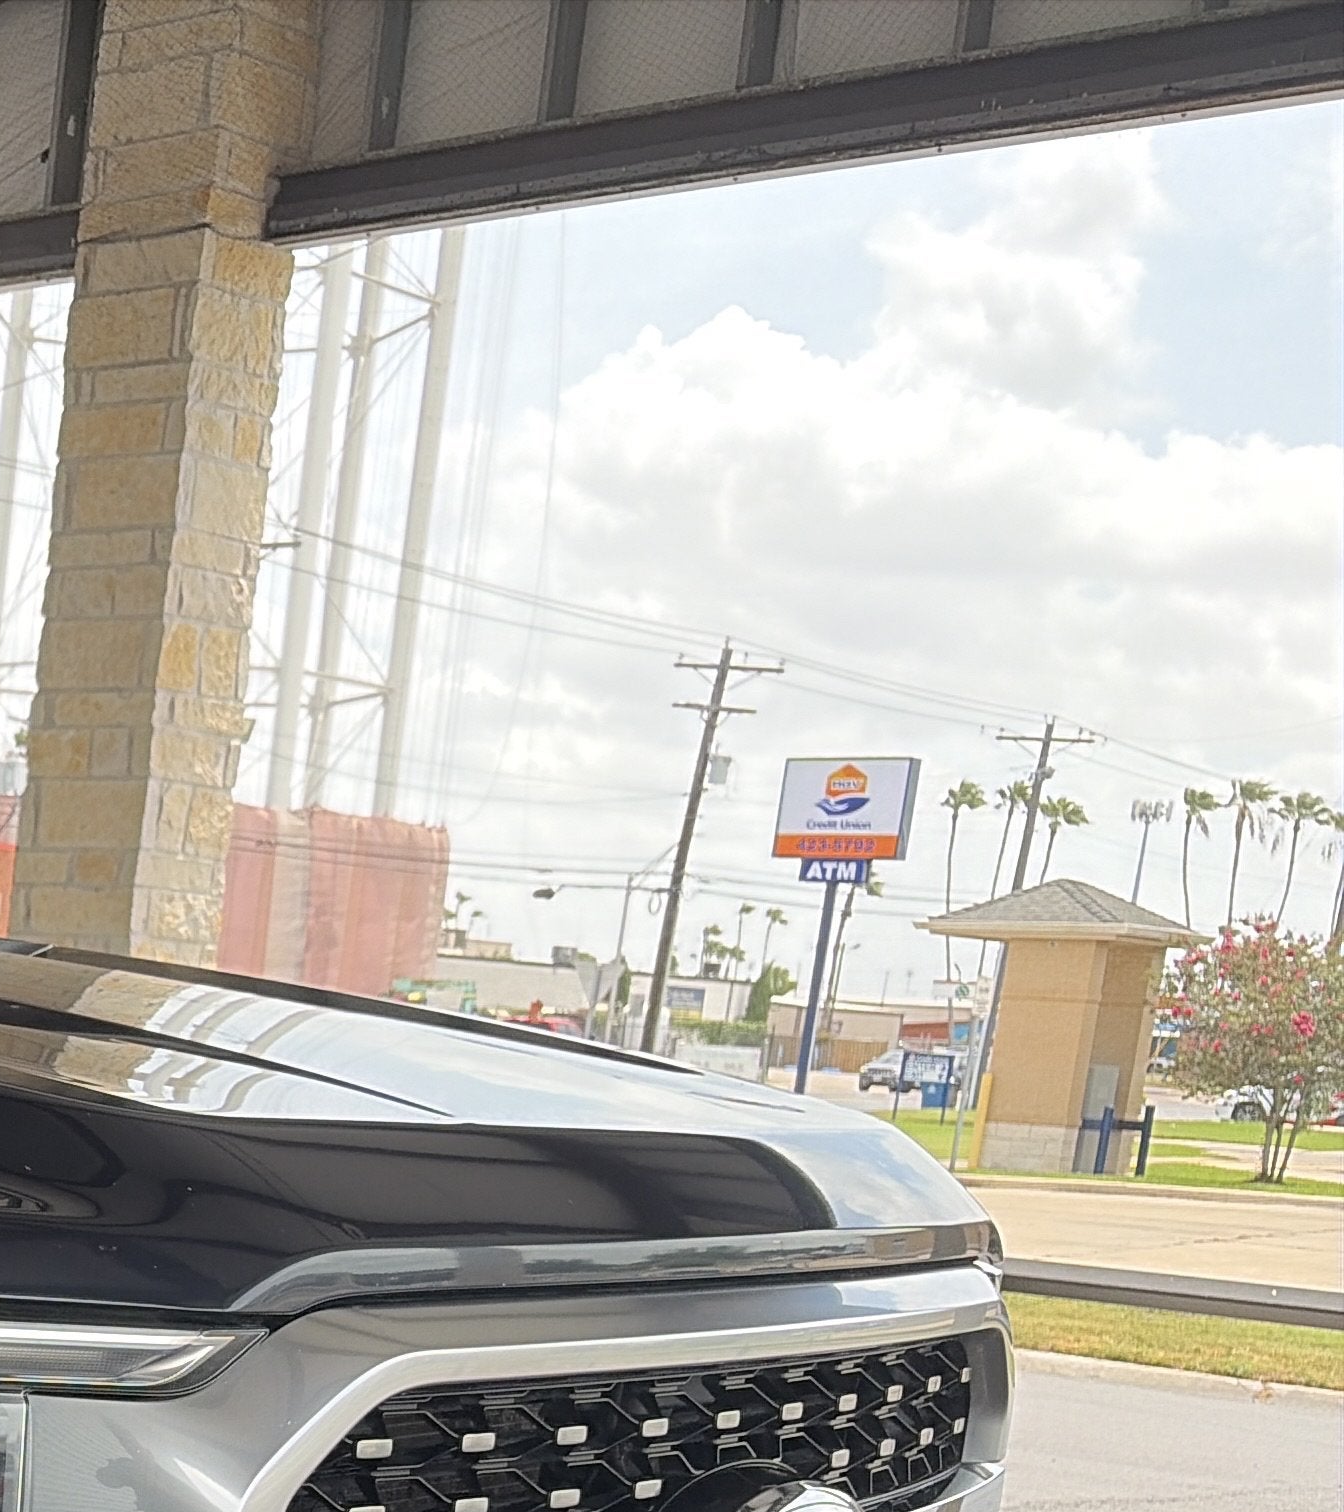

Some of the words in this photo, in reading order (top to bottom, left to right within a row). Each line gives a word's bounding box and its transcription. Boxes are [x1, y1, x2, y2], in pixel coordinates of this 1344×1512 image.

[806, 820, 837, 831] Credit
[840, 820, 872, 831] Union
[805, 861, 857, 881] ATM
